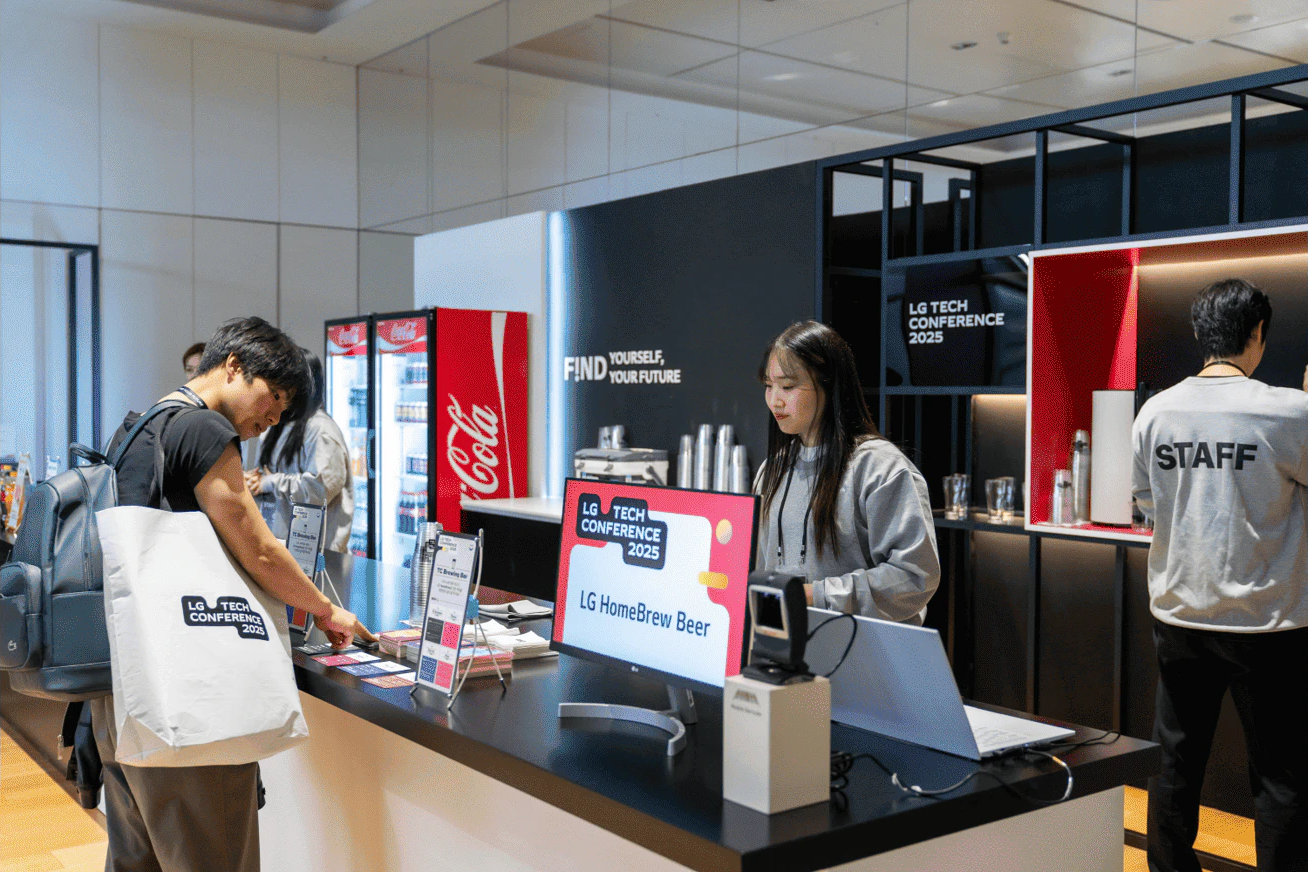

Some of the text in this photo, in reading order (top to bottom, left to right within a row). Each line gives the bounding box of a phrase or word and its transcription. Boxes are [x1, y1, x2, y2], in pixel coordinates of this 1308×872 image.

[909, 299, 968, 315] LG TECH
[908, 312, 1005, 330] CONFERENCE
[909, 331, 944, 344] 2025
[609, 349, 665, 366] YOURSELF,
[609, 369, 681, 384] YOUR FUTURE
[1155, 441, 1258, 471] STAFF
[582, 502, 645, 522] LG TECH
[581, 518, 662, 542] CONFERENCE
[627, 542, 660, 560] 2025
[443, 568, 460, 578] Brewing
[188, 601, 250, 612] LG TECH
[580, 590, 711, 637] LG HomeBrew Beer
[189, 613, 262, 625] CONFERENCE
[242, 624, 265, 635] 2025
